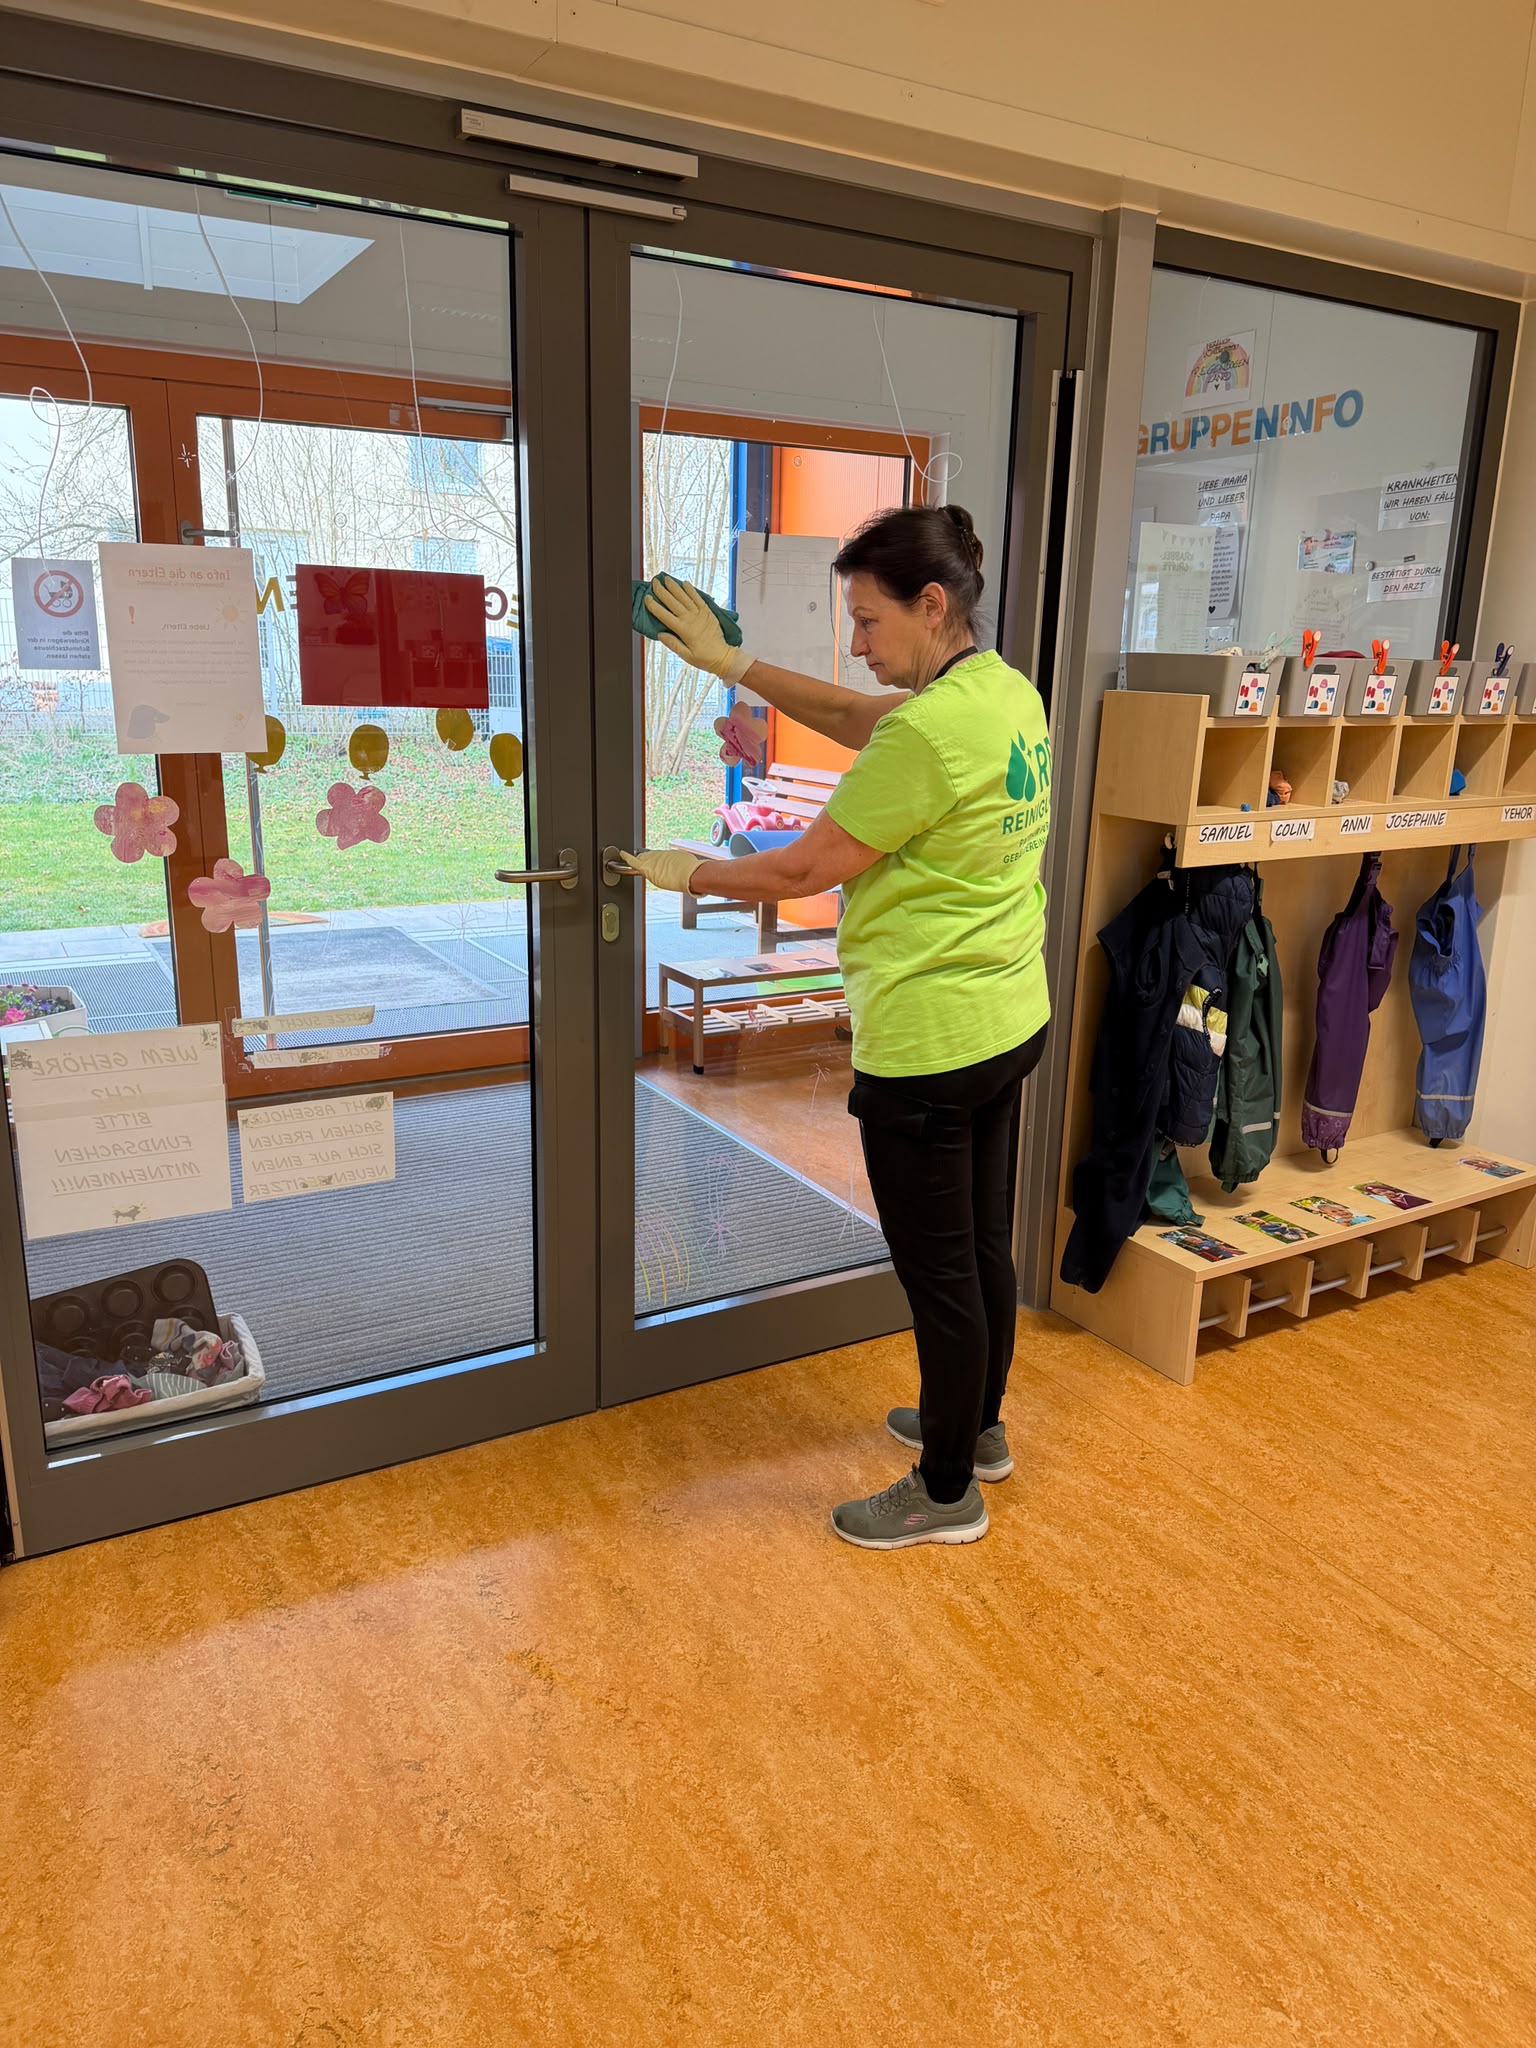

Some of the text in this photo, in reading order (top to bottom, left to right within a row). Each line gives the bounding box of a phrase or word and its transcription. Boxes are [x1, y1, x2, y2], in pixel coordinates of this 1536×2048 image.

[1137, 389, 1364, 455] GRUPPENINFO
[1198, 474, 1248, 491] LIEBE MAMA
[1198, 491, 1245, 508] UND LIEBER
[1383, 490, 1457, 509] WIR HABEN FÄLL
[1210, 511, 1231, 522] PAPA
[1409, 510, 1431, 521] VON:
[1371, 565, 1442, 580] BESTÄTIGT DURCH
[1383, 581, 1427, 593] DEN ARZT
[1386, 811, 1446, 829] JOSEPHINE
[1504, 806, 1533, 820] YEHOR
[1275, 821, 1311, 837] COLIN
[1340, 815, 1371, 832] ANNI
[1199, 825, 1252, 843] SAMUEL
